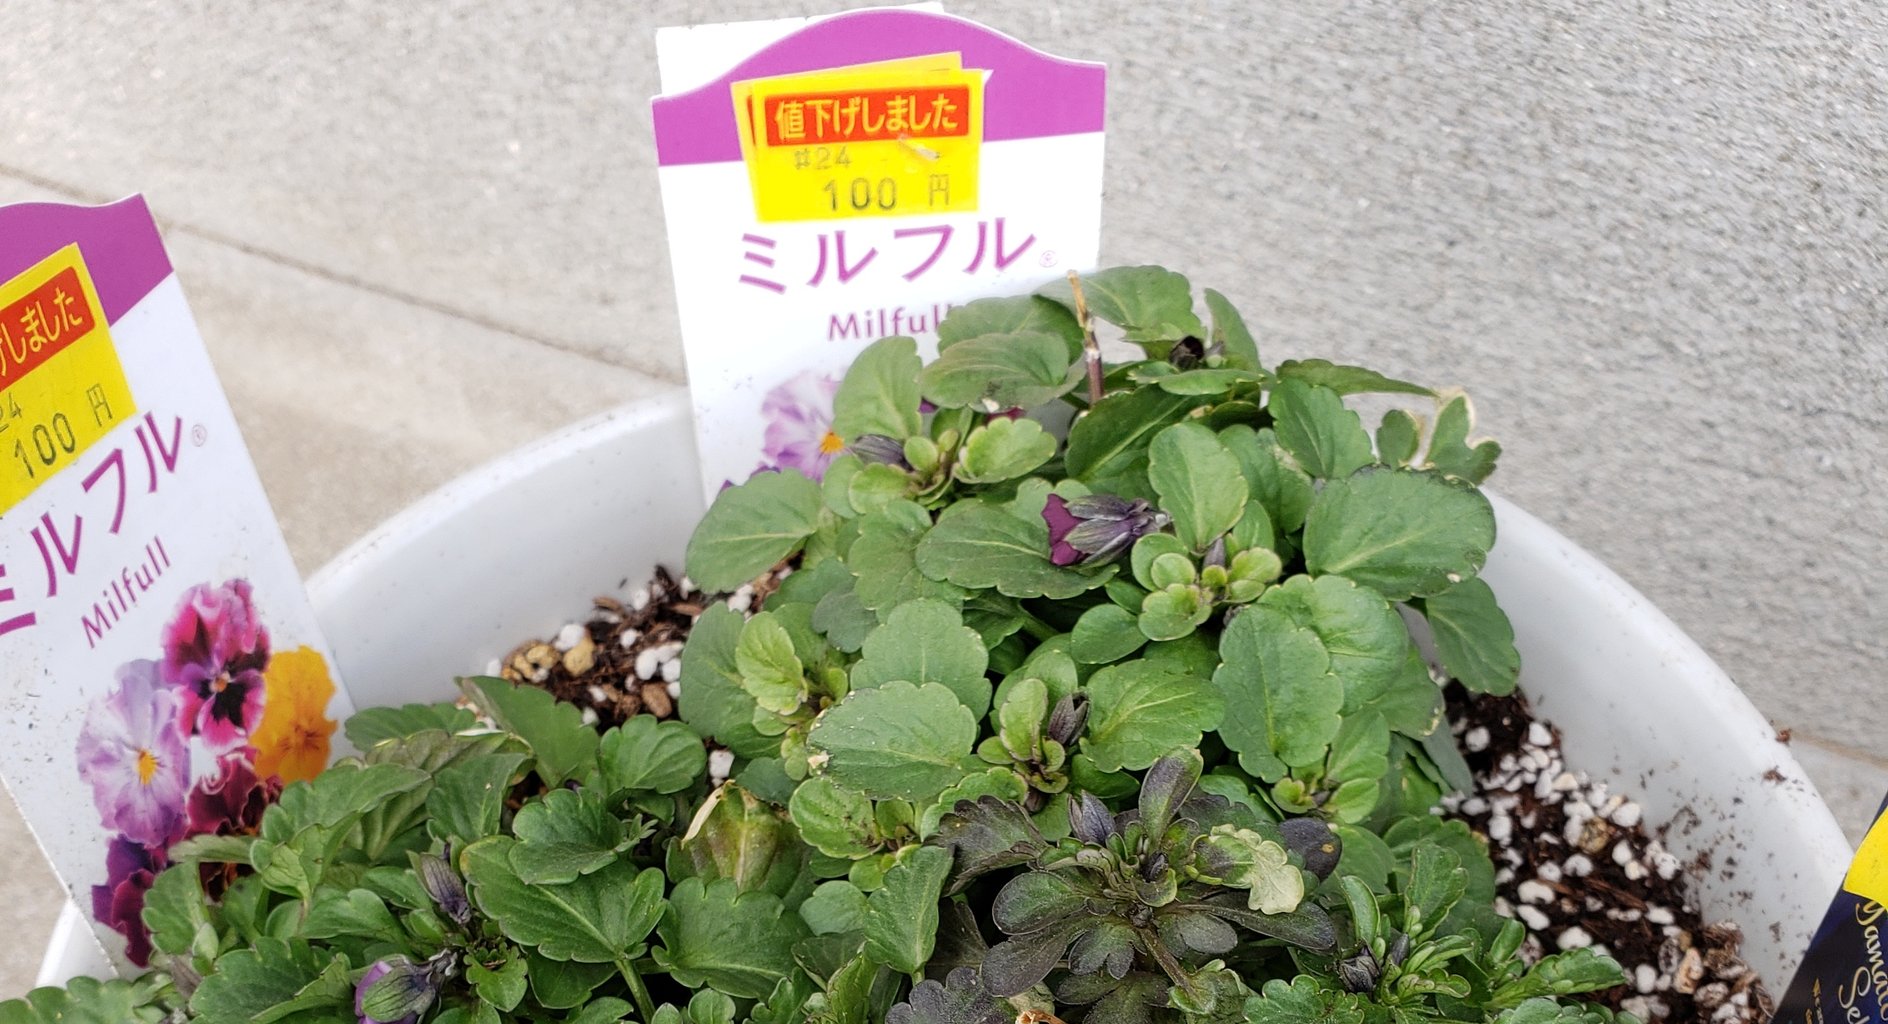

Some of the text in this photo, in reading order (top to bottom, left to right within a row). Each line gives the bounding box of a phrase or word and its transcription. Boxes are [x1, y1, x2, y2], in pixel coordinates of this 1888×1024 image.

[775, 93, 958, 140] 値下げしました
[823, 173, 950, 211] 100 円
[739, 217, 1036, 294] ミルフル
[828, 303, 952, 340] Milful
[14, 383, 113, 479] 100 円
[81, 535, 171, 648] Milfull
[1812, 977, 1821, 1007] We
